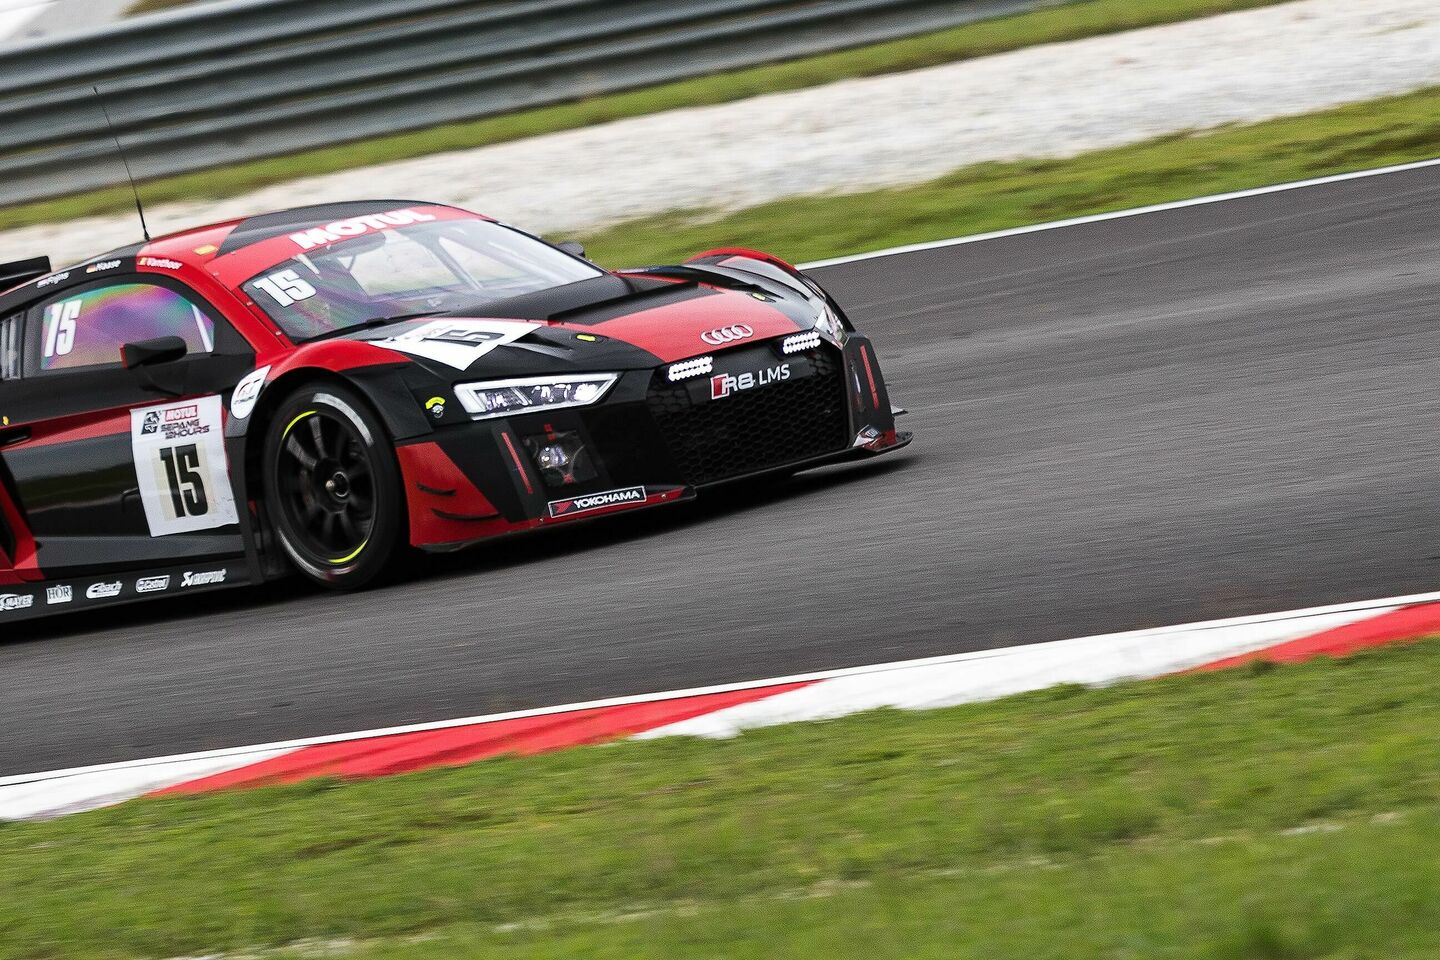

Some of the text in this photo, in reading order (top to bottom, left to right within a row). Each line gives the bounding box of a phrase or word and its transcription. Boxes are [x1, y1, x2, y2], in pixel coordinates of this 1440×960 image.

[289, 209, 436, 249] MOTUL
[252, 269, 316, 307] 15
[44, 299, 83, 358] 15
[419, 329, 505, 347] 15
[721, 363, 791, 395] R8 LMS
[160, 419, 200, 433] SEPANG
[166, 406, 197, 420] MOTUL
[159, 443, 209, 518] 15
[573, 490, 641, 509] YOKOHAMA
